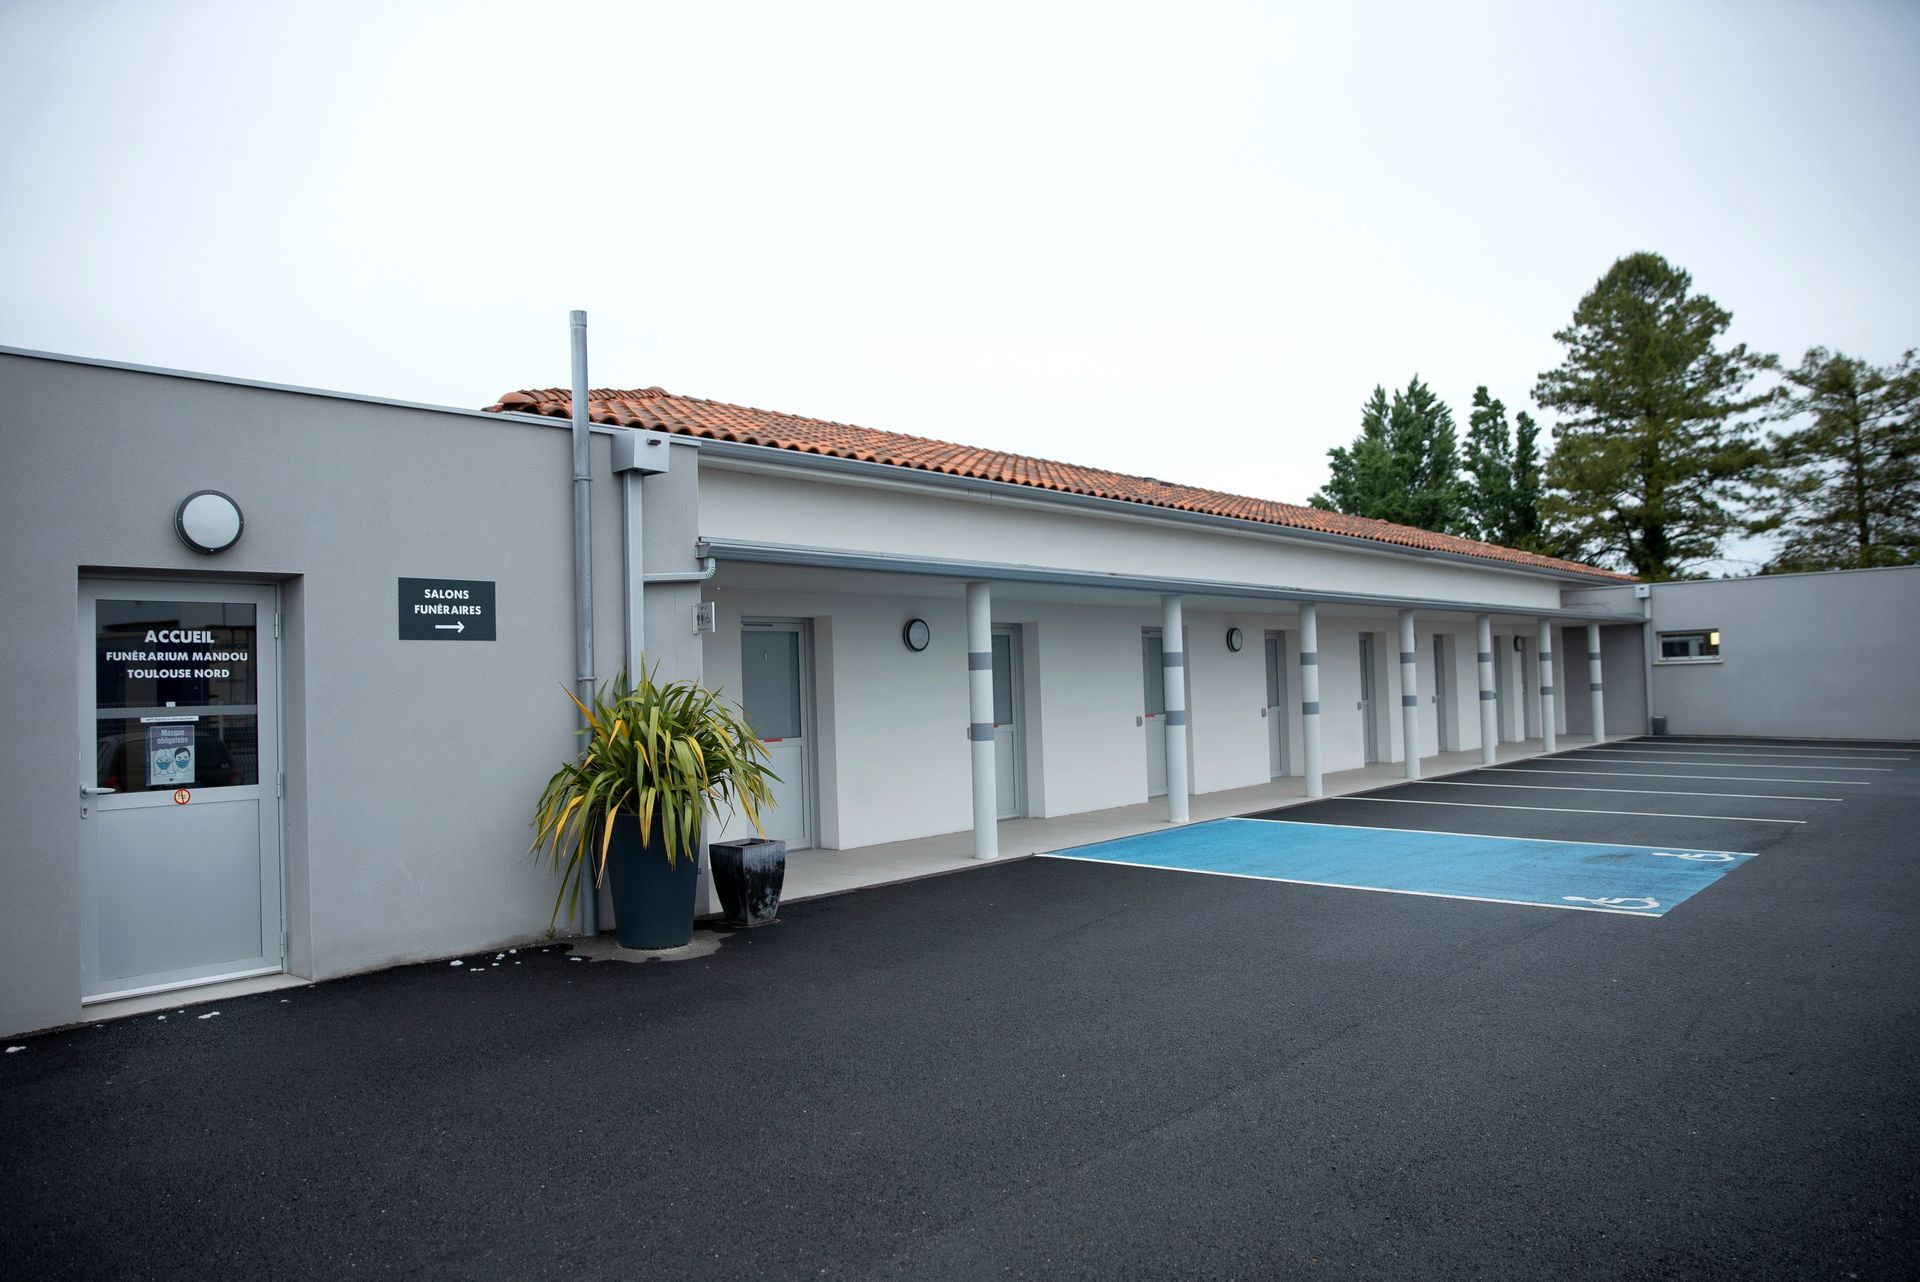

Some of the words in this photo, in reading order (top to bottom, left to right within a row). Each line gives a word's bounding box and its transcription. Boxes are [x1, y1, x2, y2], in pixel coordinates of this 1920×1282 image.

[424, 589, 469, 599] SALONS
[414, 604, 481, 615] FUNÉRAIRES
[144, 630, 215, 643] ACCUEIL
[105, 650, 188, 661] FUNÉRARIUM
[192, 652, 248, 661] MANDOU
[127, 669, 191, 679] TOULOUSE
[194, 669, 230, 678] NORD
[161, 729, 185, 737] Masque
[157, 736, 188, 744] obligatoire
